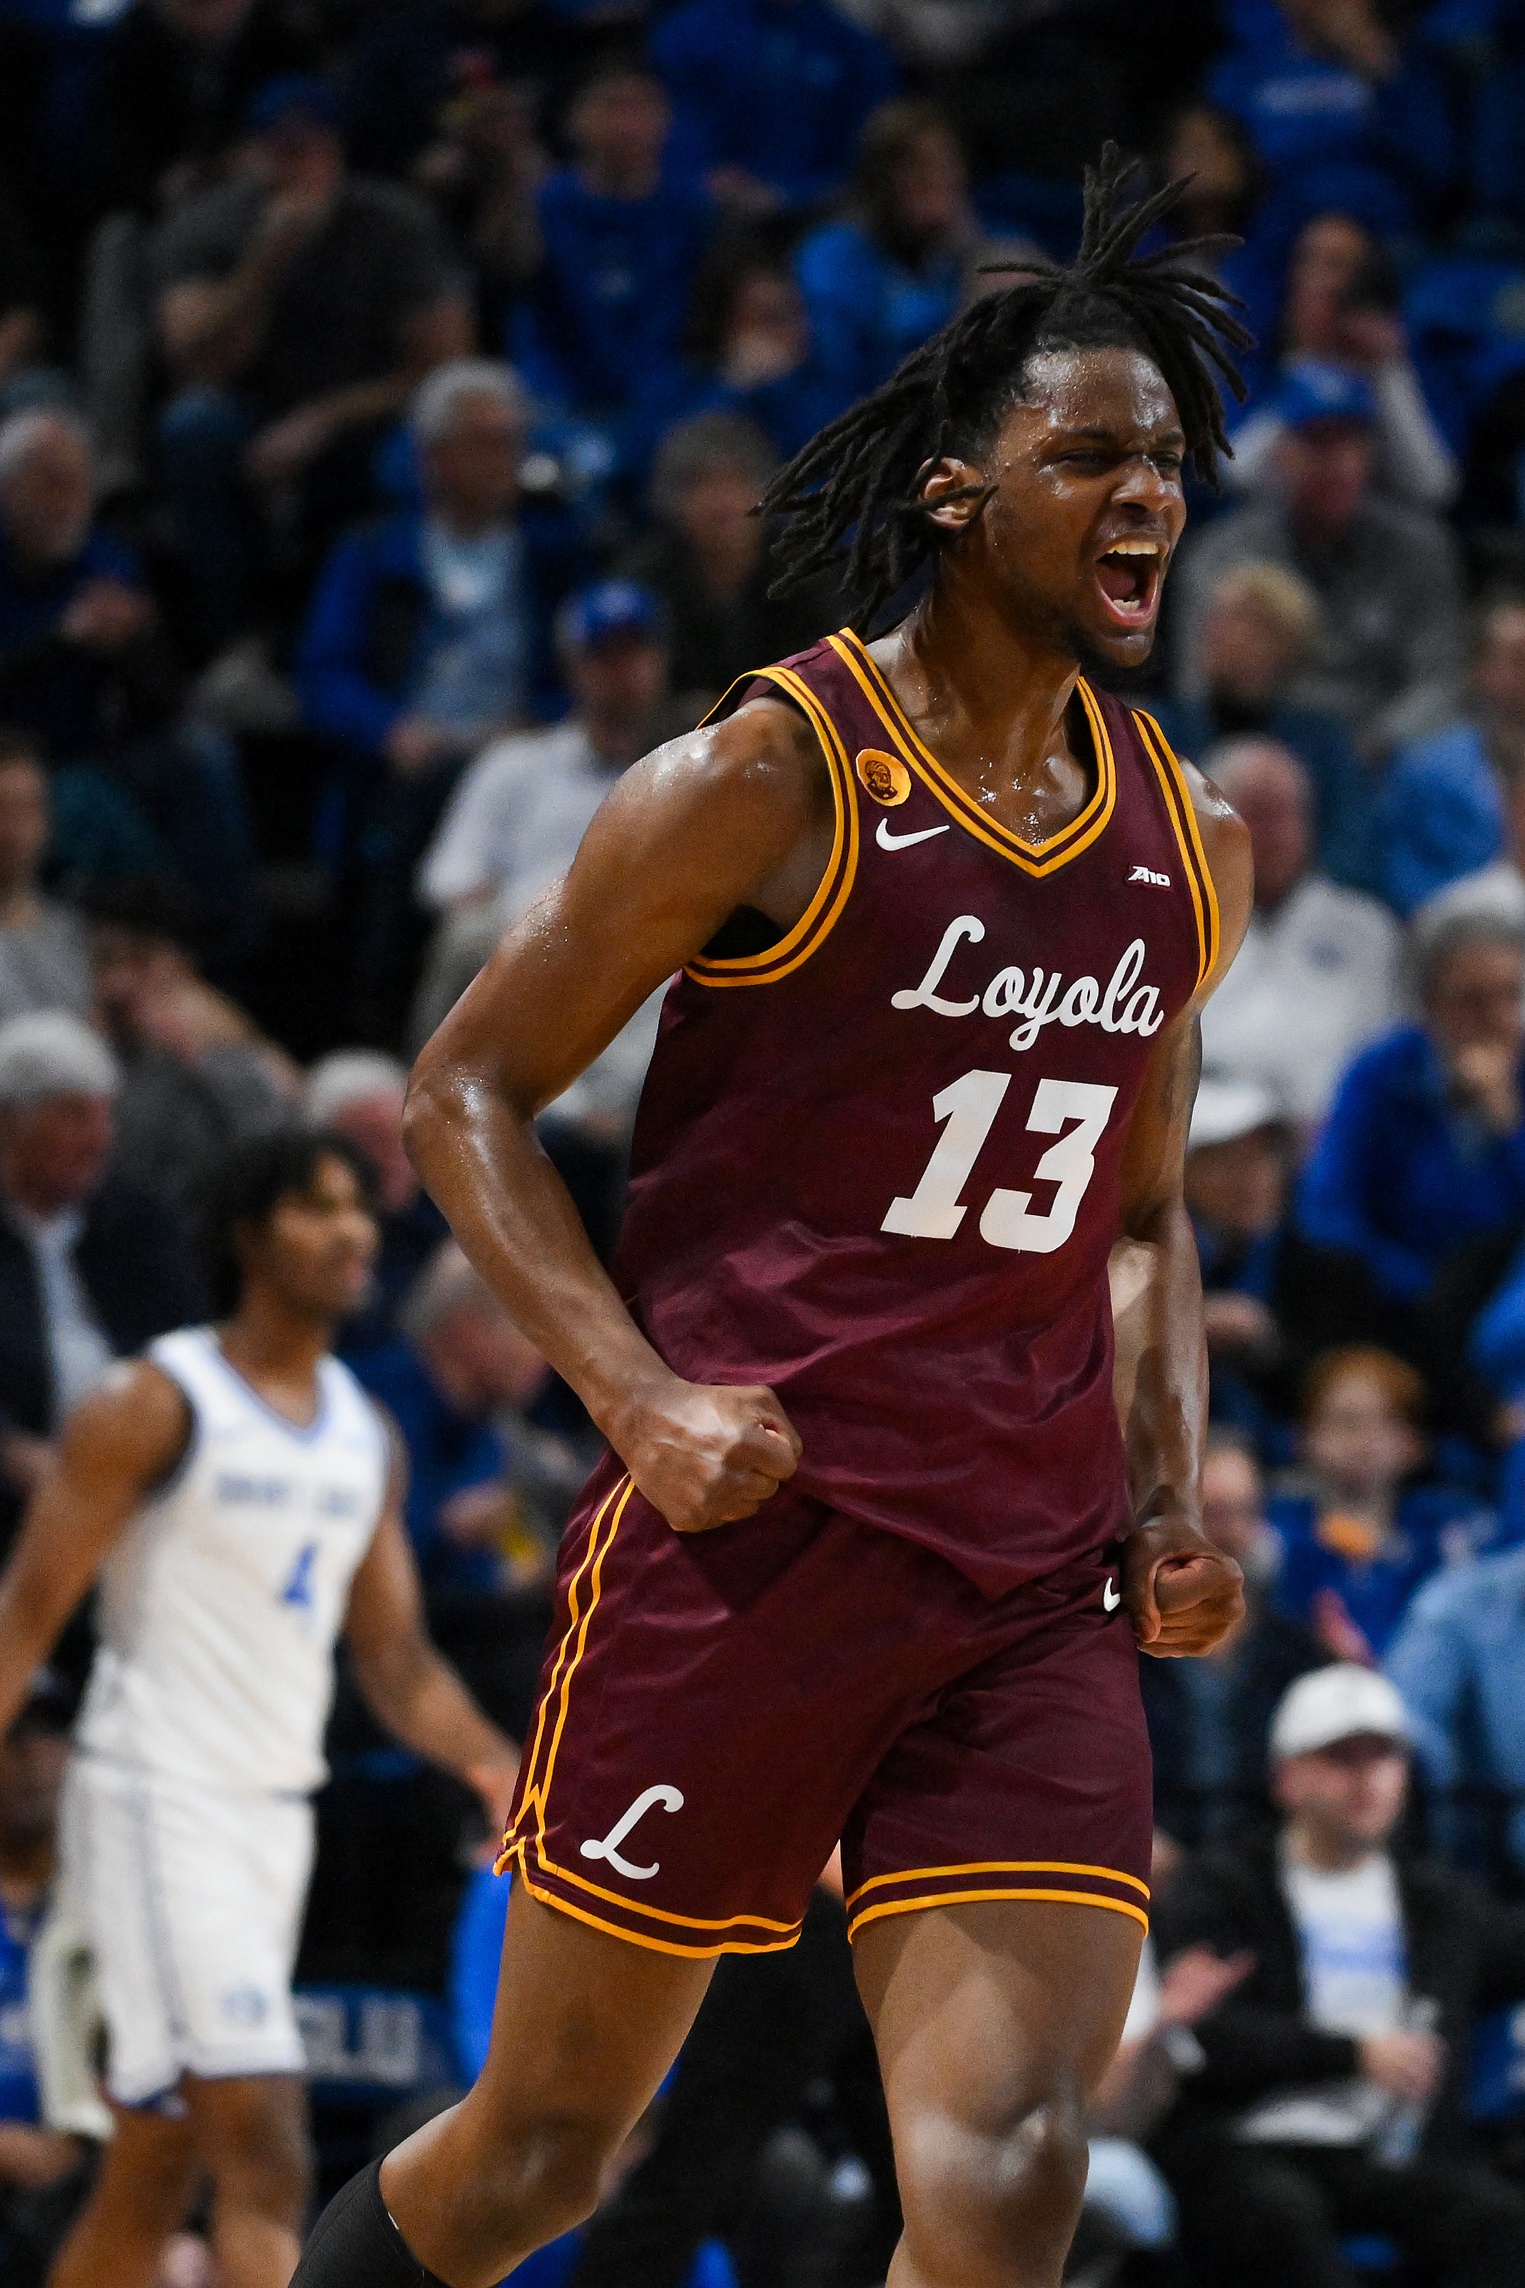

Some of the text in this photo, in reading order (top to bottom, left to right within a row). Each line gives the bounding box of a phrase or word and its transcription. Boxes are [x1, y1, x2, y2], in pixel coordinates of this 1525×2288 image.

[1127, 865, 1171, 887] A10
[891, 915, 1164, 1051] Loyola
[880, 1069, 1119, 1254] 13
[580, 1784, 684, 1880] L
